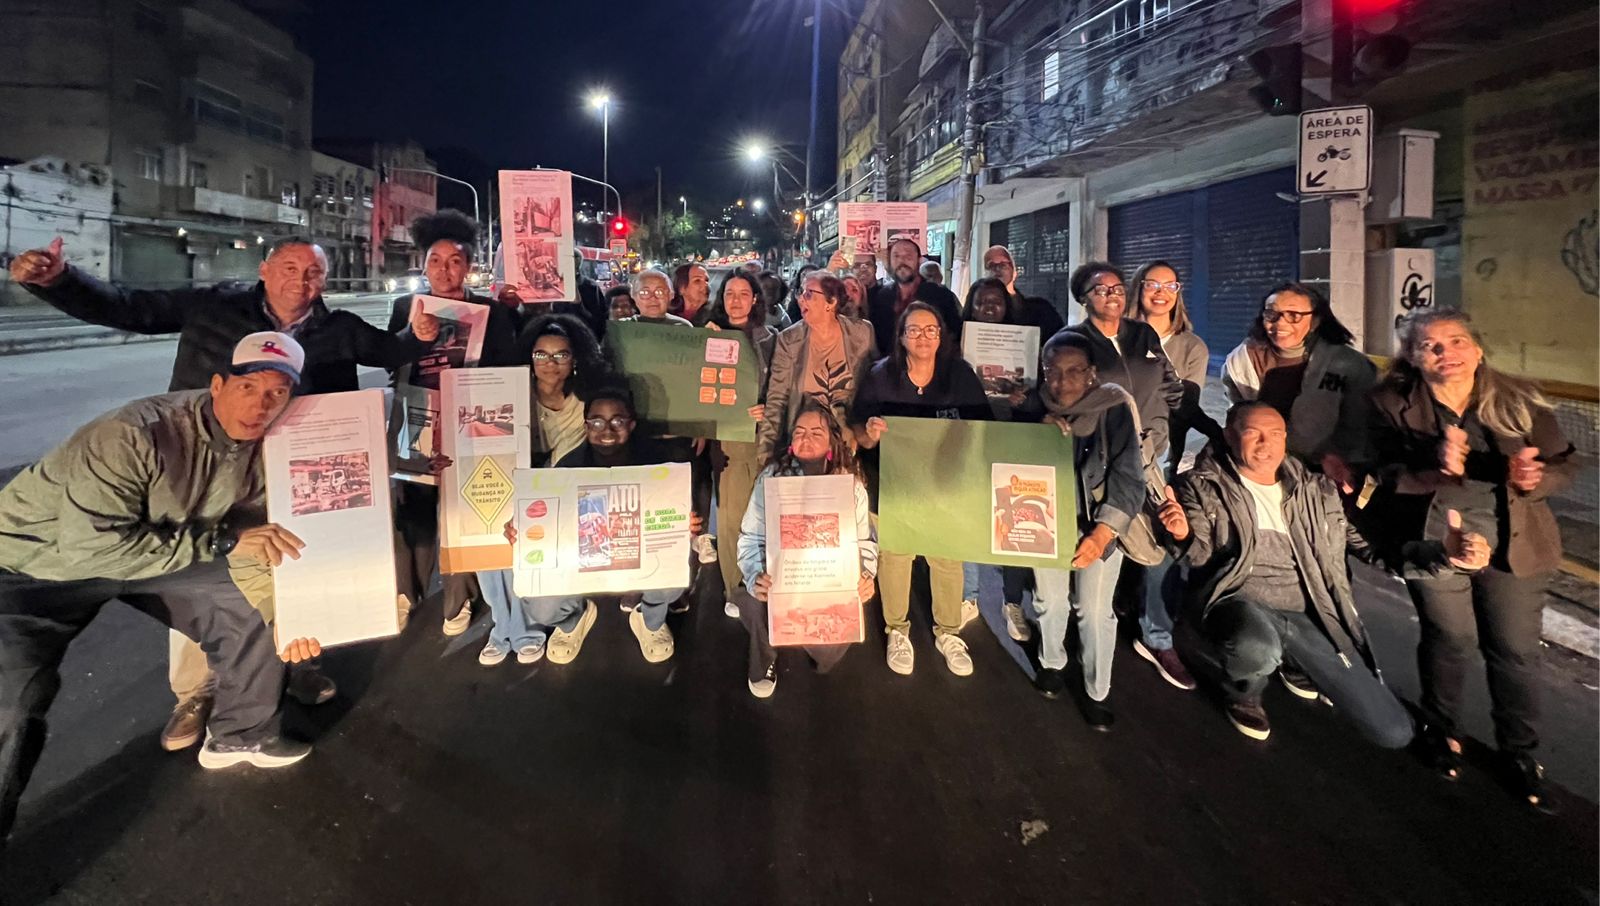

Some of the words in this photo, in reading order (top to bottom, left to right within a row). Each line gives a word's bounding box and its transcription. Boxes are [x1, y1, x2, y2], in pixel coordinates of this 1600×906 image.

[1306, 117, 1342, 129] ÁREA
[1346, 115, 1364, 125] DE
[1307, 128, 1361, 140] ESPERA
[608, 484, 639, 512] ATO
